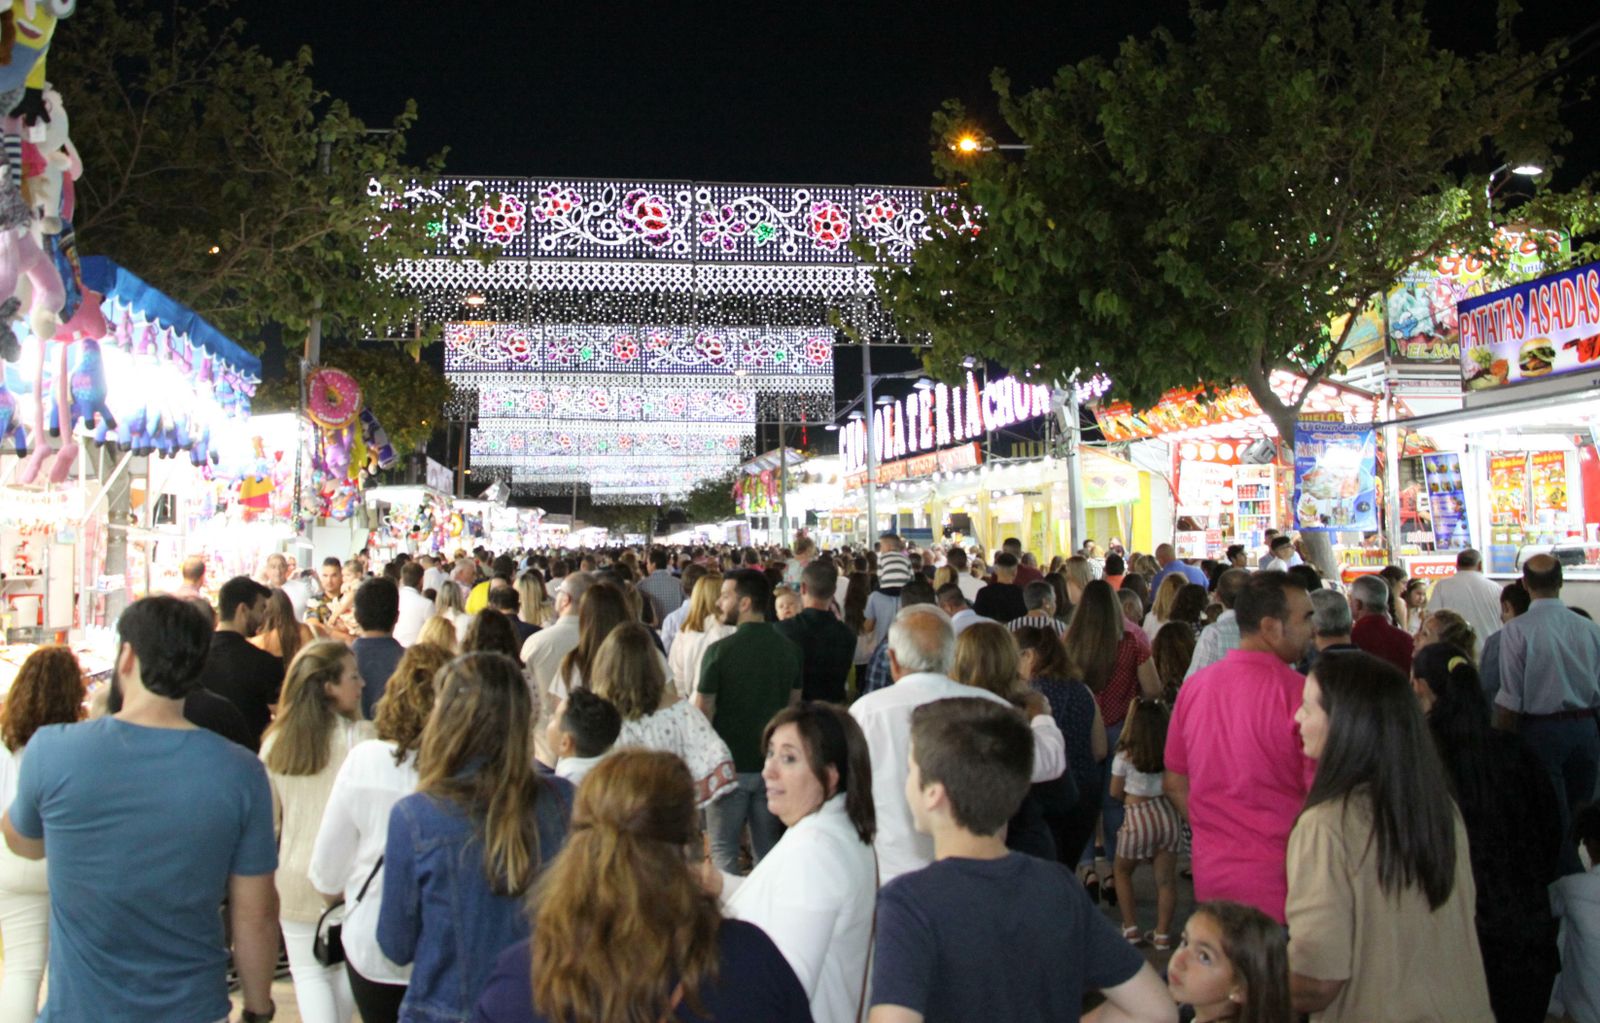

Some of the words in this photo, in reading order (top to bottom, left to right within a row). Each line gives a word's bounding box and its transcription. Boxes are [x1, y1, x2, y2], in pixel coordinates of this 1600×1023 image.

[1459, 293, 1525, 350] PATATAS
[1529, 269, 1600, 336] ASADAS
[838, 370, 982, 476] CHOOLATERIA
